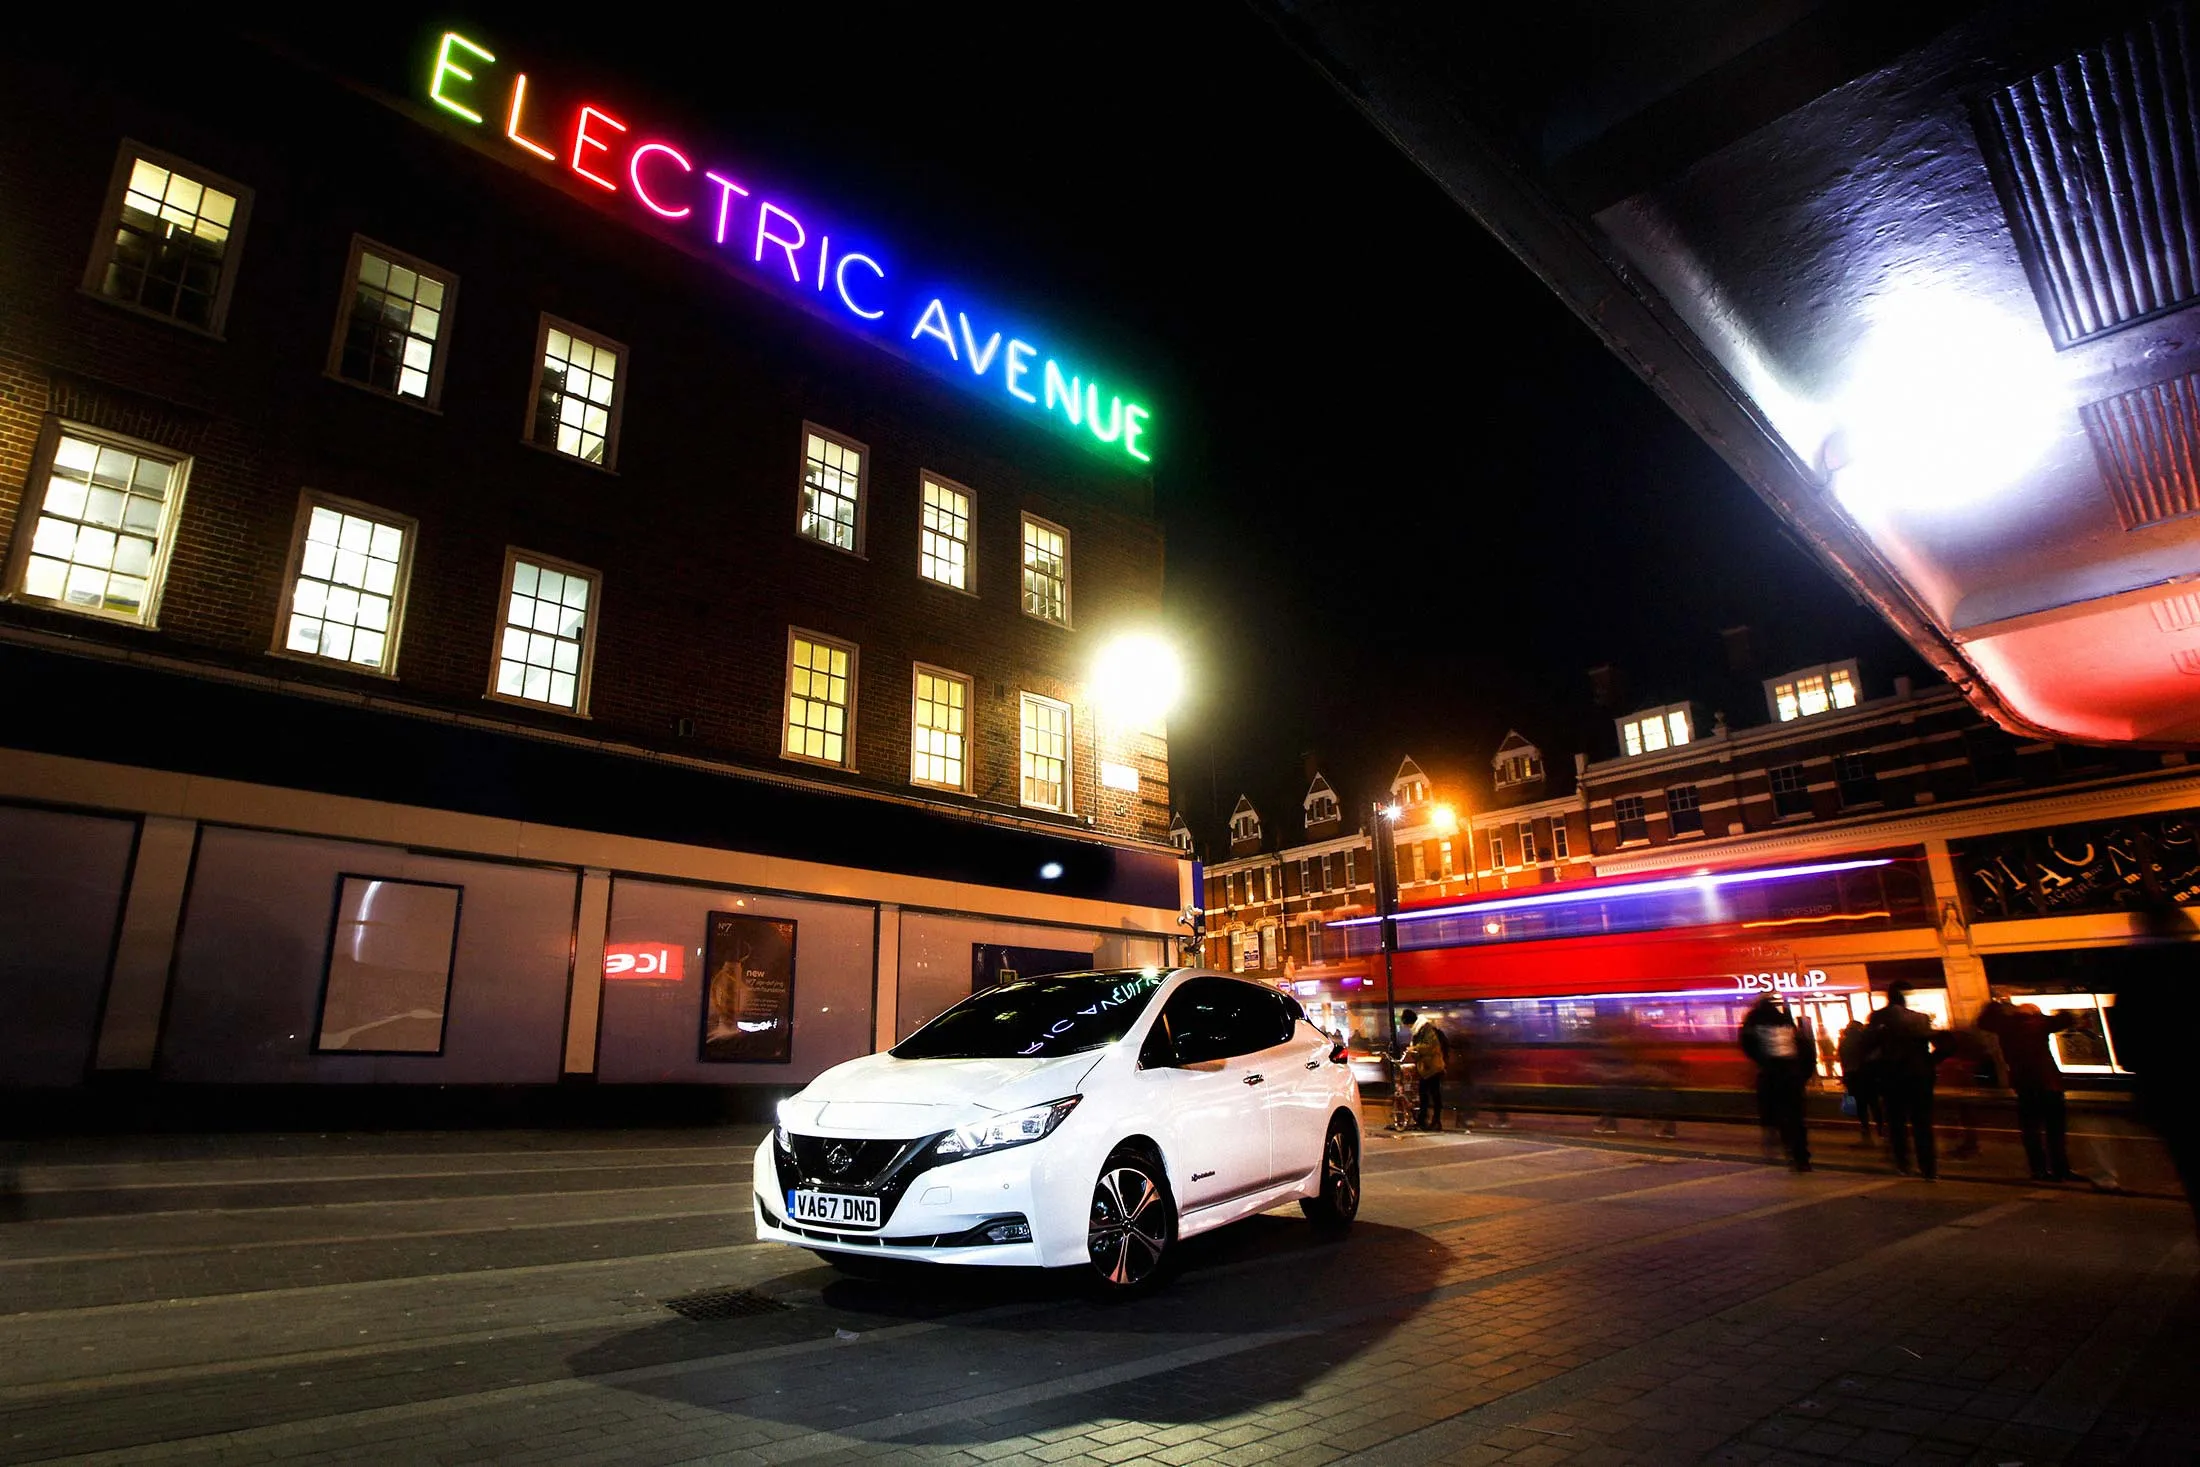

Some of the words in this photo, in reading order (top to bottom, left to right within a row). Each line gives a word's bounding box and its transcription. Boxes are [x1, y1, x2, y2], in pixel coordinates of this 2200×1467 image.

[429, 31, 885, 320] ELECTRIC
[910, 298, 1151, 464] AVENUE
[798, 1194, 839, 1219] VA67
[842, 1198, 877, 1223] DND
